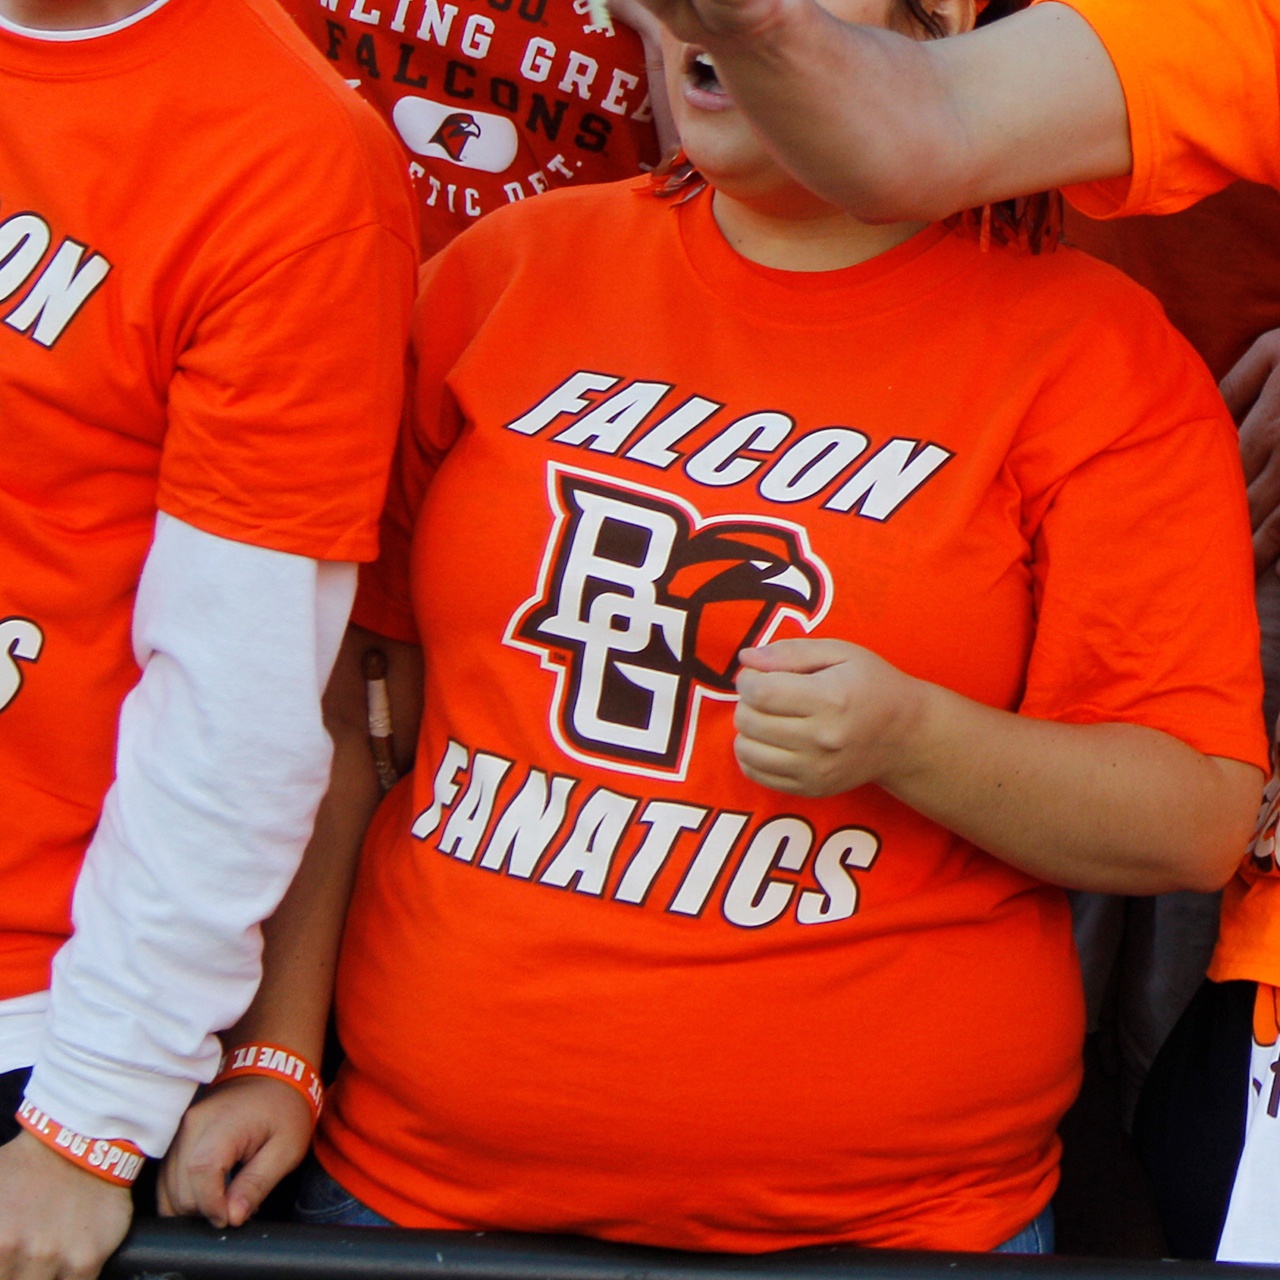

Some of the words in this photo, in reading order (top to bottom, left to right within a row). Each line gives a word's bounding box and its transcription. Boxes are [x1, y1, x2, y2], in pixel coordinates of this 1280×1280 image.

[325, 18, 613, 155] FALCONS
[504, 369, 957, 523] FALCON
[411, 738, 881, 929] FANATICS
[257, 1047, 306, 1082] LIVE
